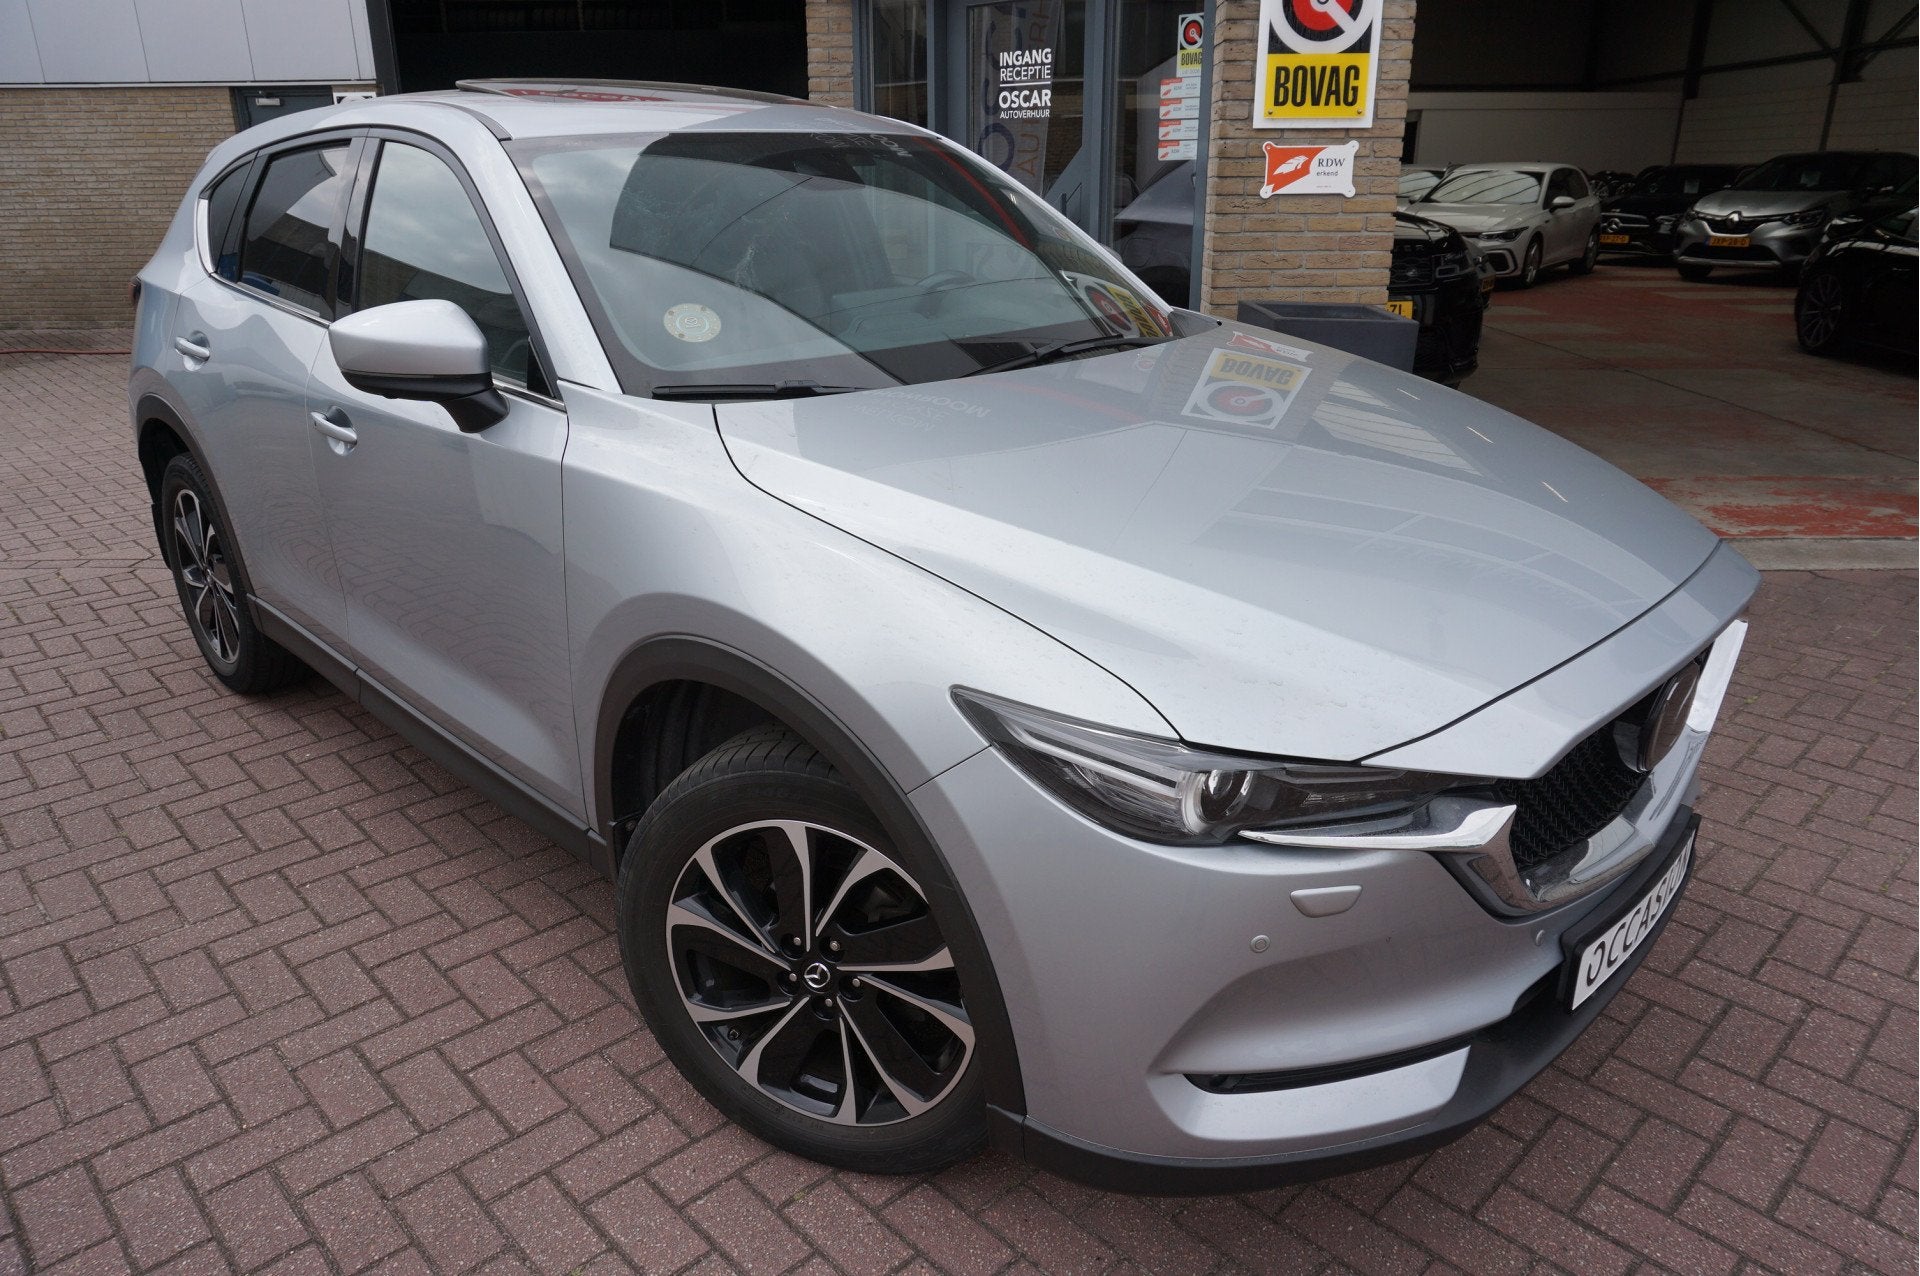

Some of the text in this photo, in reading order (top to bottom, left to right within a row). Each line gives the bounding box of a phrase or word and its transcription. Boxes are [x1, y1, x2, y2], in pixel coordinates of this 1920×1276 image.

[999, 48, 1052, 67] INGANG
[999, 65, 1051, 82] RECEPTIE
[1273, 65, 1360, 108] BOVAG
[998, 89, 1052, 109] OSCAR
[999, 108, 1051, 119] AUTOVERHUUR
[1317, 157, 1346, 168] RDW
[1316, 169, 1339, 177] erkend
